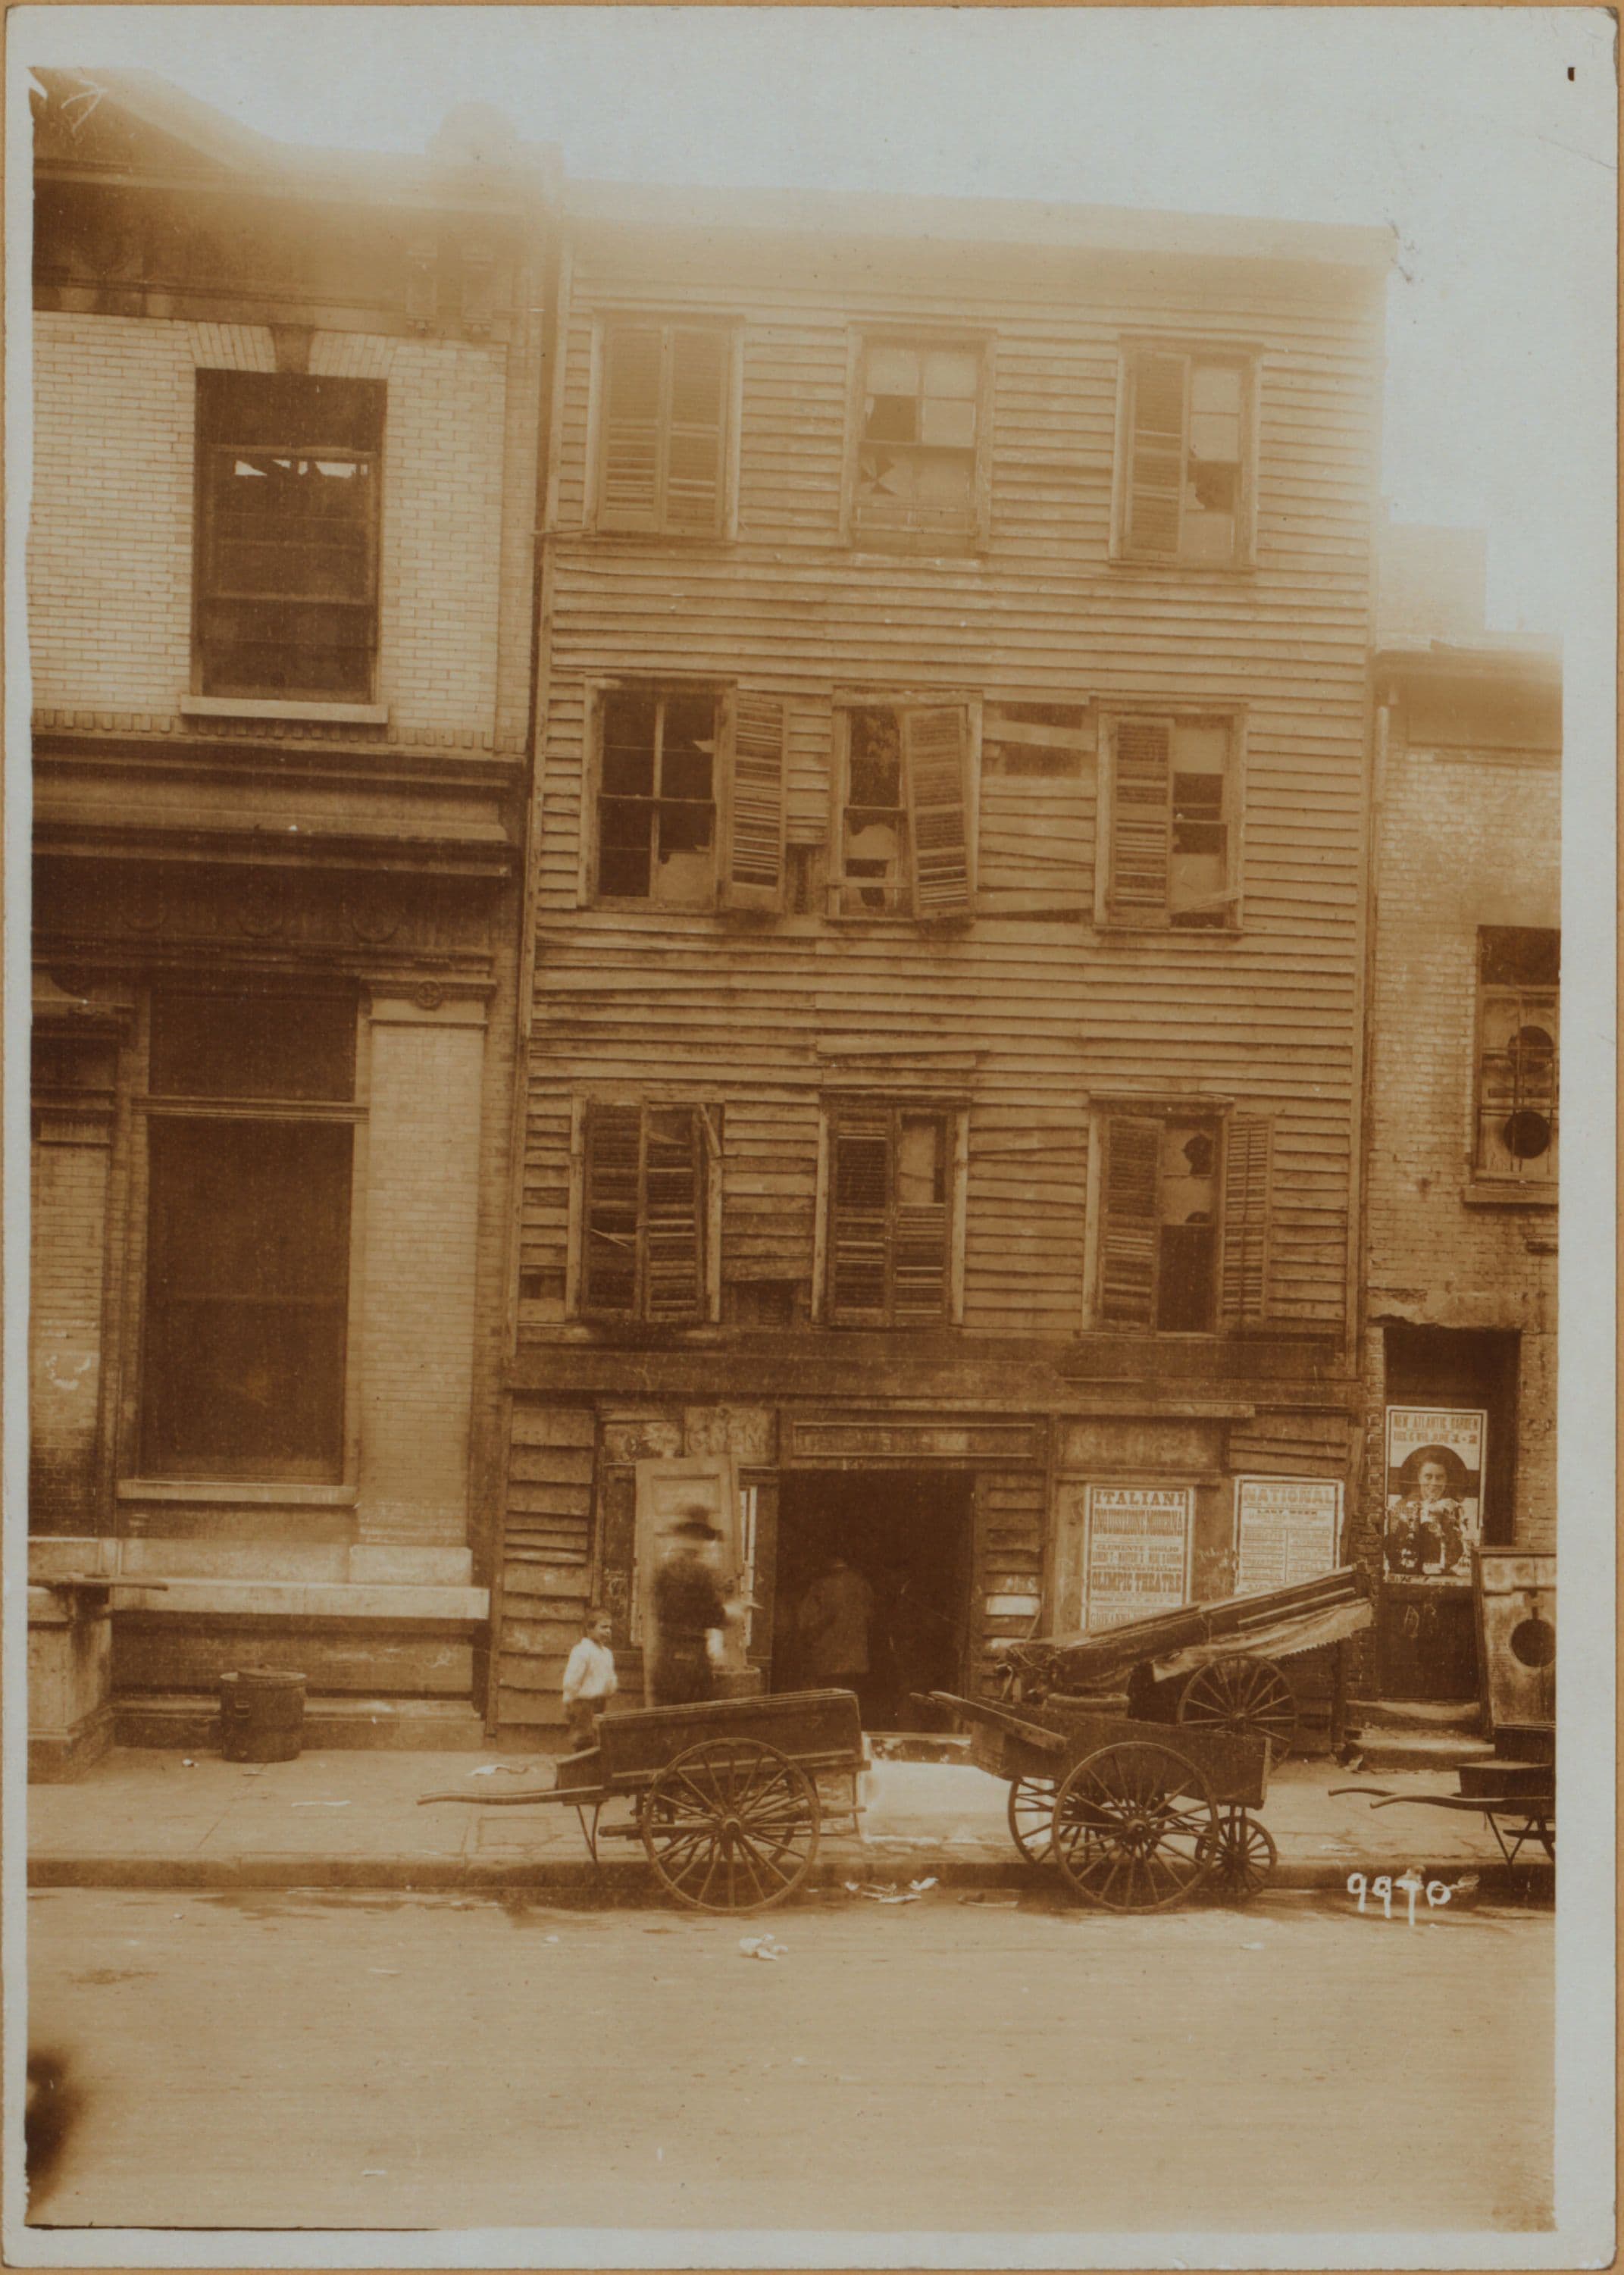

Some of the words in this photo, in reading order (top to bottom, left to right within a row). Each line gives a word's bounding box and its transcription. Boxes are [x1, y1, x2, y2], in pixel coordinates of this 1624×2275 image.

[1413, 1416, 1447, 1430] ATLANTIC
[1095, 1491, 1184, 1507] ITALIANI
[1243, 1488, 1335, 1504] NATIONAL
